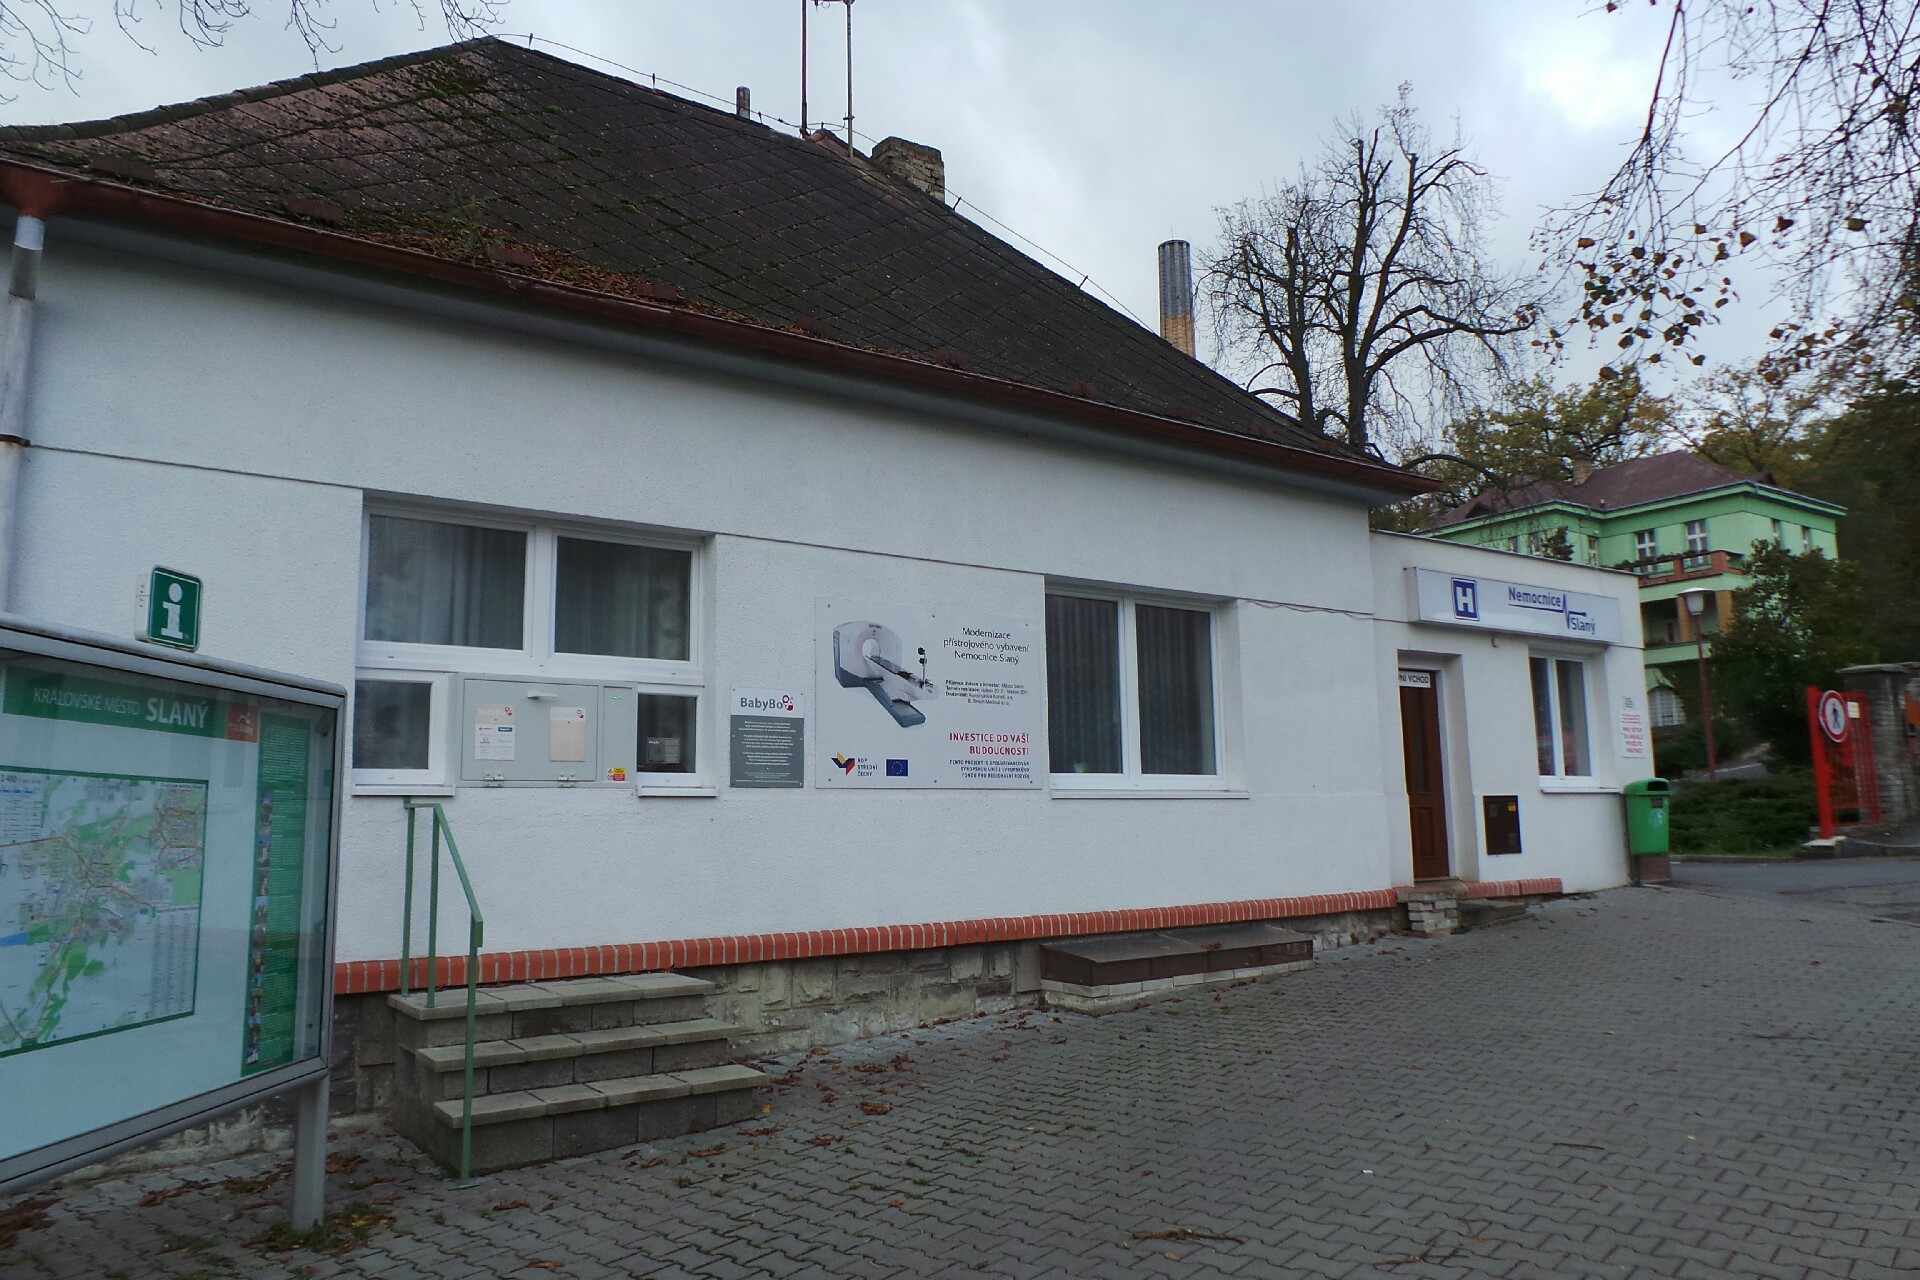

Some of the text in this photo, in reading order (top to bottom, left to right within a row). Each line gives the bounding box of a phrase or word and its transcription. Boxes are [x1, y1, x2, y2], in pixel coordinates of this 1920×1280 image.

[1508, 586, 1561, 607] Nemocnice
[962, 627, 1011, 639] Modernizace
[1570, 617, 1596, 635] Slaný
[943, 638, 1030, 652] přístrojového vybavení
[954, 650, 1020, 665] Nemocnice Slaný
[1408, 674, 1429, 684] VCHOD
[33, 687, 210, 729] KRÁLOVSKÉ MĚSTO SLANÝ
[949, 733, 1029, 743] INVESTICE DO VAŠÍ
[969, 746, 1029, 756] BUDOUCNOSTI
